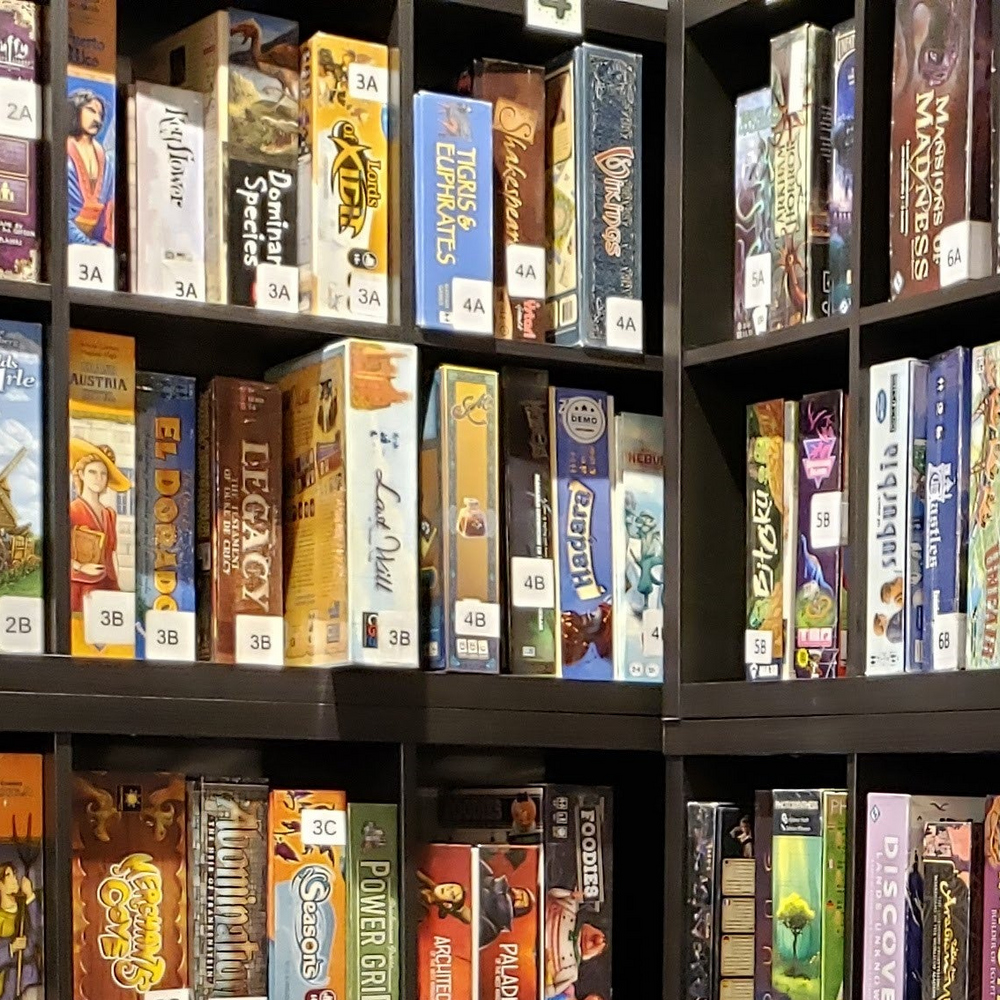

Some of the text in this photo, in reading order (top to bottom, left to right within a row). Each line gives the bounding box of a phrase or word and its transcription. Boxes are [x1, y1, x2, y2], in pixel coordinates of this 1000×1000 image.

[356, 73, 378, 92] 3A
[7, 103, 33, 122] 2A
[159, 106, 195, 209] Keyflower
[458, 147, 477, 214] TIGRIS
[911, 89, 936, 282] MADNESS
[435, 141, 456, 266] EUPHRATES
[236, 176, 269, 268] Species
[947, 250, 962, 267] 6A
[78, 264, 103, 283] 3A
[515, 263, 537, 280] 4A
[751, 272, 765, 288] 5A
[175, 282, 198, 299] 3A
[268, 283, 291, 301] 3A
[358, 289, 381, 307] 3A
[463, 297, 485, 314] 4A
[616, 314, 637, 332] 4A
[70, 373, 128, 393] AUSTRIA
[570, 414, 598, 426] DEMO
[154, 416, 182, 461] EL
[877, 443, 899, 569] suburbia
[241, 439, 271, 612] LEGACY
[816, 511, 830, 528] 5B
[375, 468, 402, 594] Last Will
[567, 486, 594, 590] Hadara
[524, 576, 545, 591] 4B
[5, 617, 32, 634] 2B
[100, 610, 124, 626] 3B
[464, 612, 486, 627] 4B
[157, 630, 178, 646] 3B
[250, 634, 271, 651] 3B
[389, 631, 411, 646] 3B
[754, 637, 766, 653] 5B
[939, 632, 950, 649] 6B
[312, 819, 337, 835] 3C
[579, 809, 600, 898] FOODIES
[358, 859, 390, 947] POWER
[97, 876, 131, 961] COVE
[291, 864, 336, 985] Seasons
